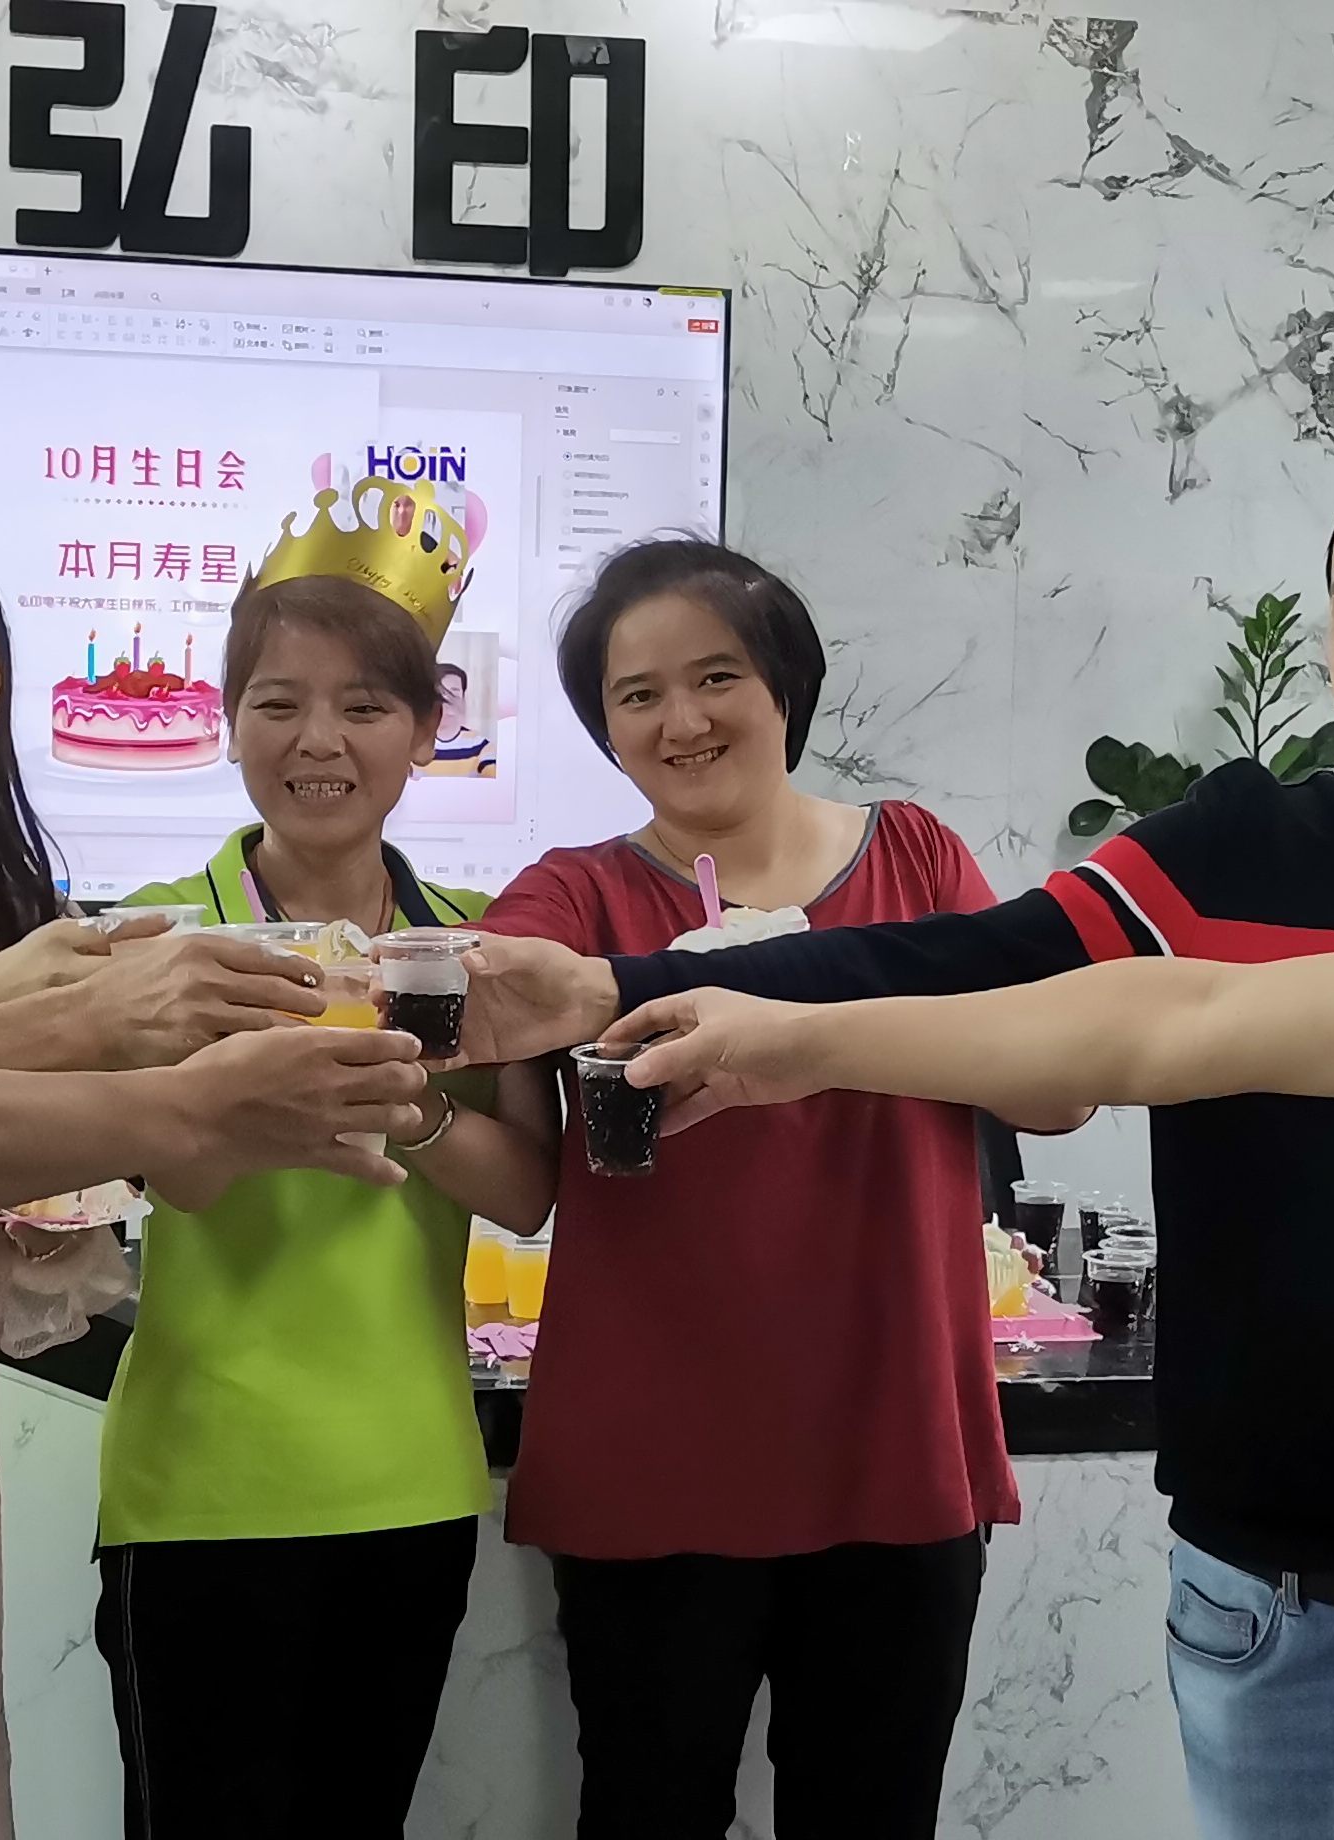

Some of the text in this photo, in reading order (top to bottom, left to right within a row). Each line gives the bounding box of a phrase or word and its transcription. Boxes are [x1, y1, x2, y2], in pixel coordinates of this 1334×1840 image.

[44, 445, 247, 491] 10月生日会
[58, 539, 239, 584] 本月寿星
